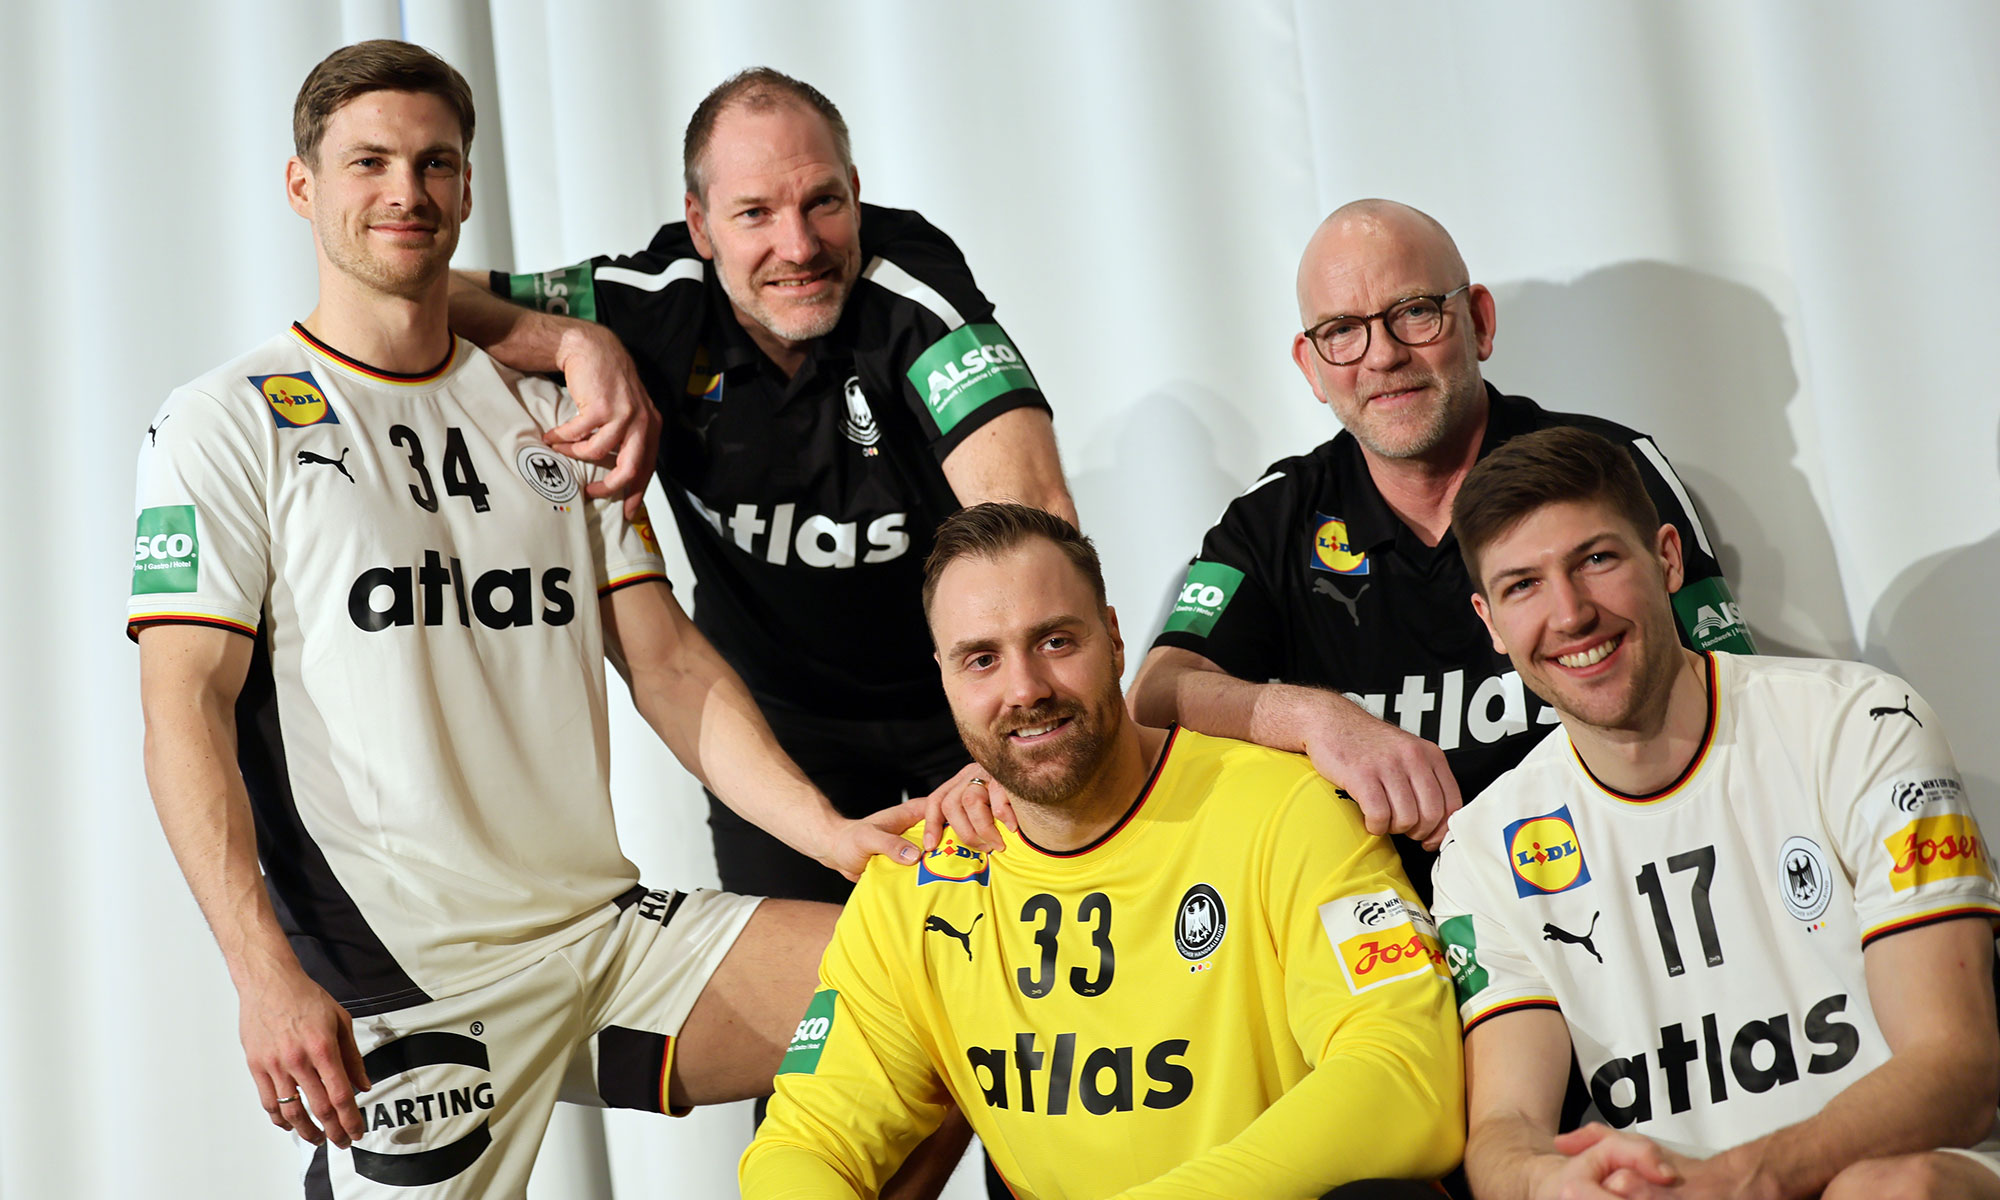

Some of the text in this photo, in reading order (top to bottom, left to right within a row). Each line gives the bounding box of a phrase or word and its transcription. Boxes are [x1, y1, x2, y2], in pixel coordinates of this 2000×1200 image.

[389, 424, 491, 513] 34
[348, 549, 575, 632] atlas
[1017, 892, 1115, 999] 33
[1636, 845, 1724, 977] 17
[966, 1032, 1194, 1116] atlas
[1590, 994, 1860, 1130] atlas
